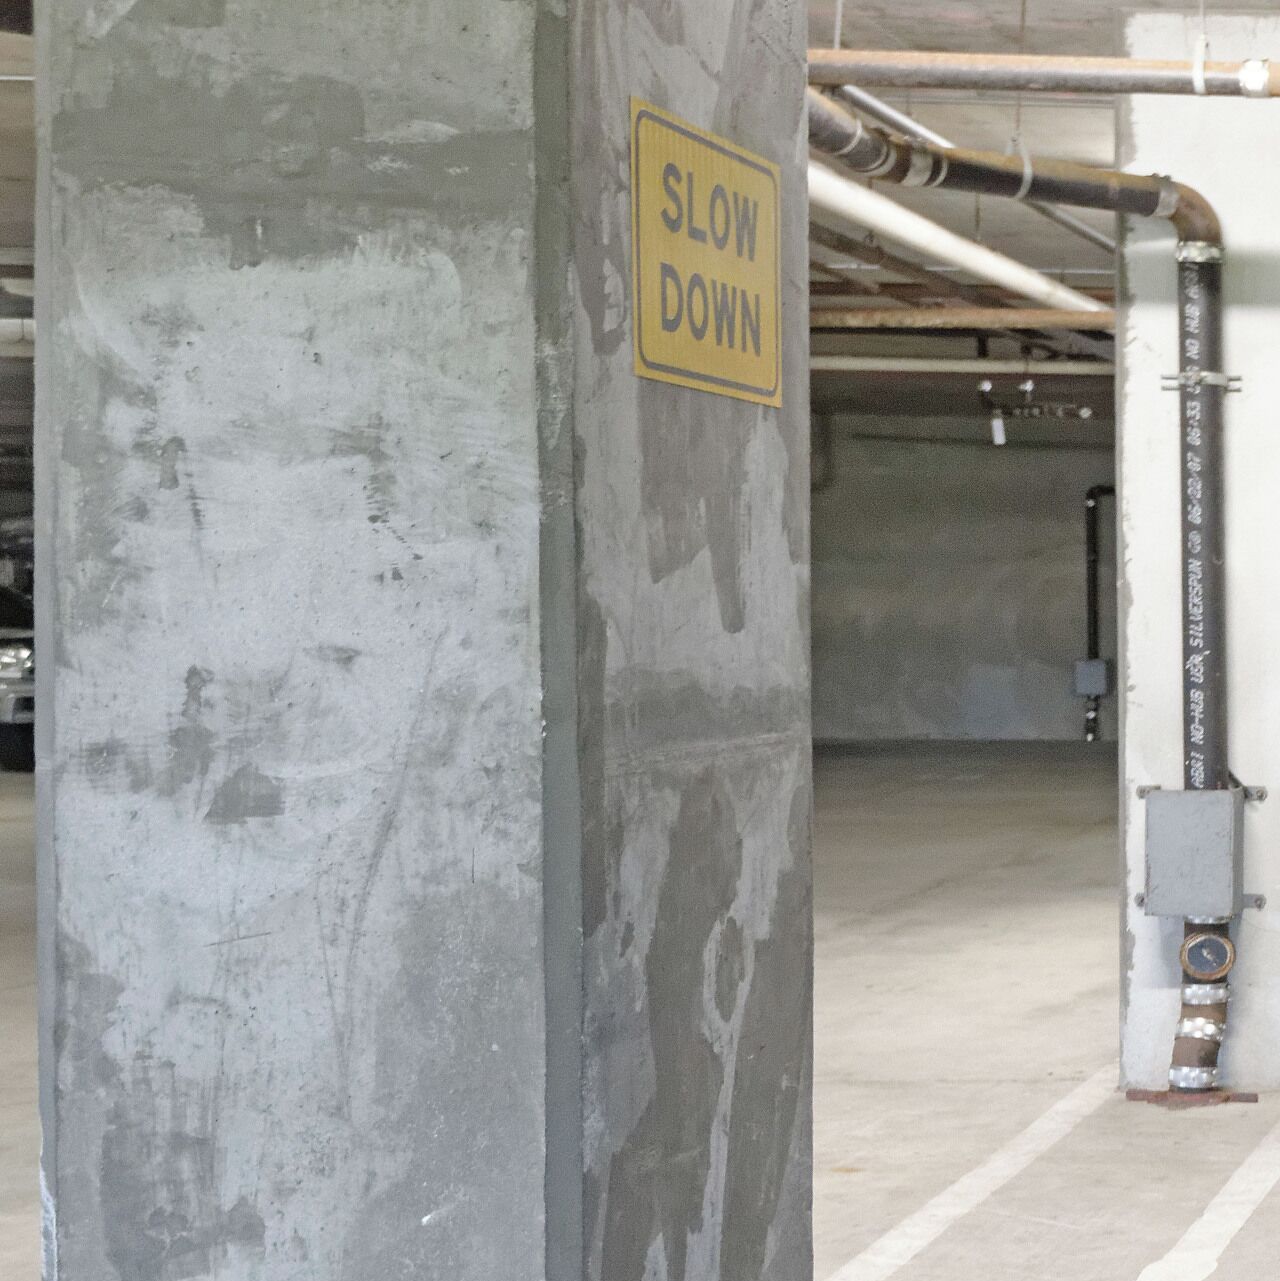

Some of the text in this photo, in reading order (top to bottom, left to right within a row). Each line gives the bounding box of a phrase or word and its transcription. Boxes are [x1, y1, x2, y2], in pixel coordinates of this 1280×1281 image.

[661, 163, 758, 262] SLOW
[660, 262, 761, 357] DOWN
[1188, 557, 1204, 648] SILVERSPUN
